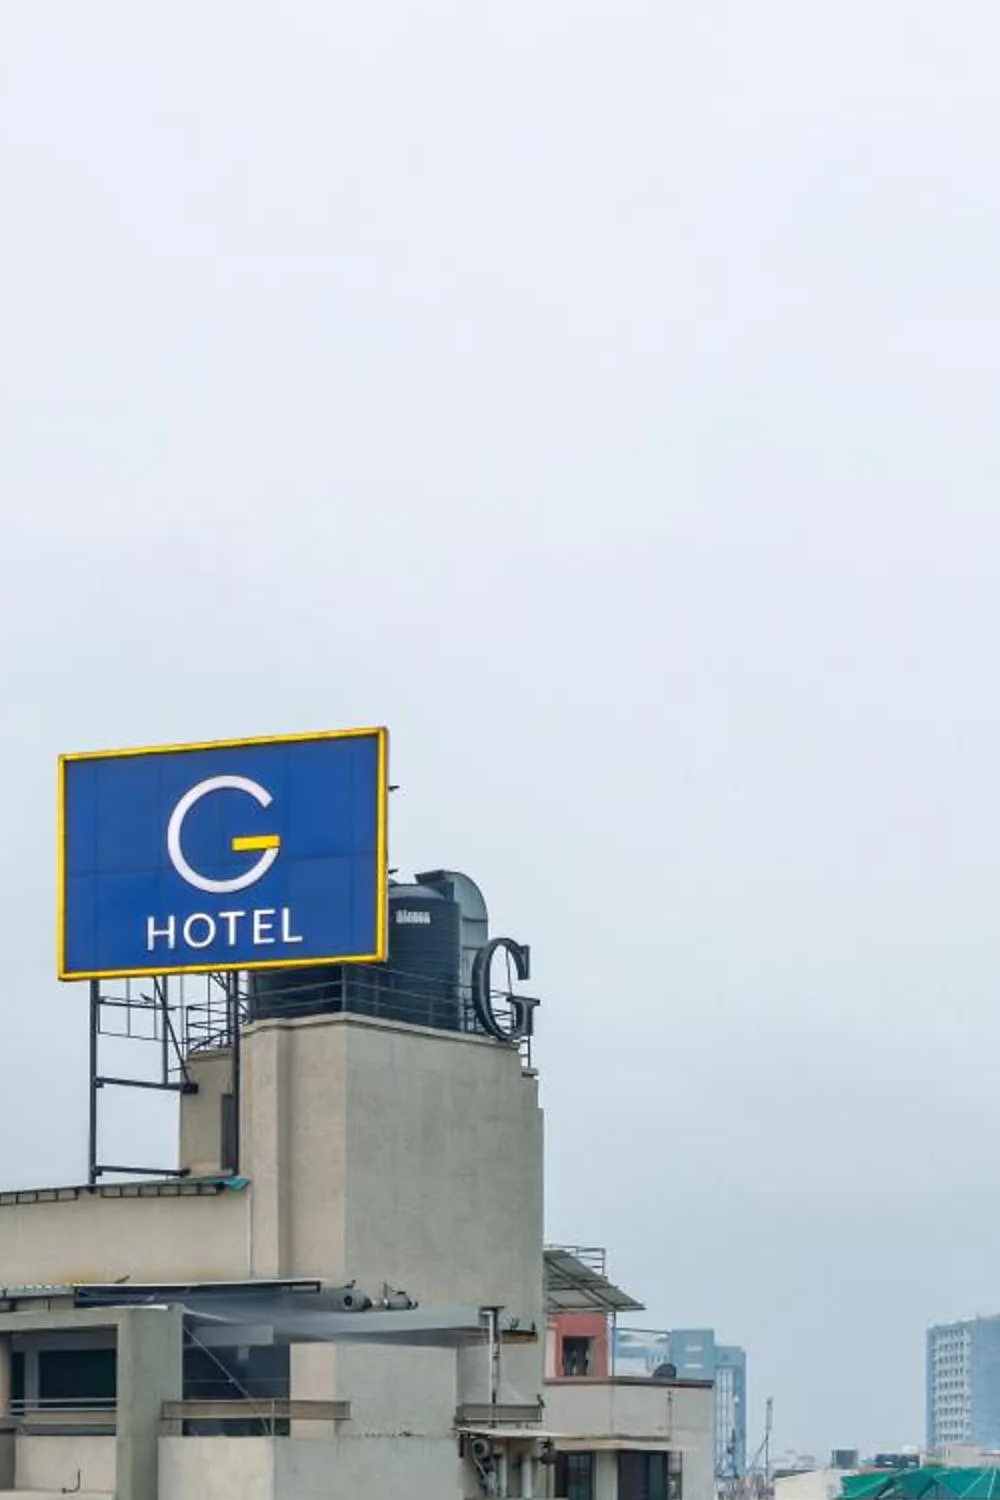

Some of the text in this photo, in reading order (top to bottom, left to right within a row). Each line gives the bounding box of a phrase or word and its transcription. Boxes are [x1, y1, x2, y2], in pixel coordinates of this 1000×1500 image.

[167, 775, 281, 894] G
[146, 907, 303, 951] HOTEL
[471, 937, 541, 1043] G
